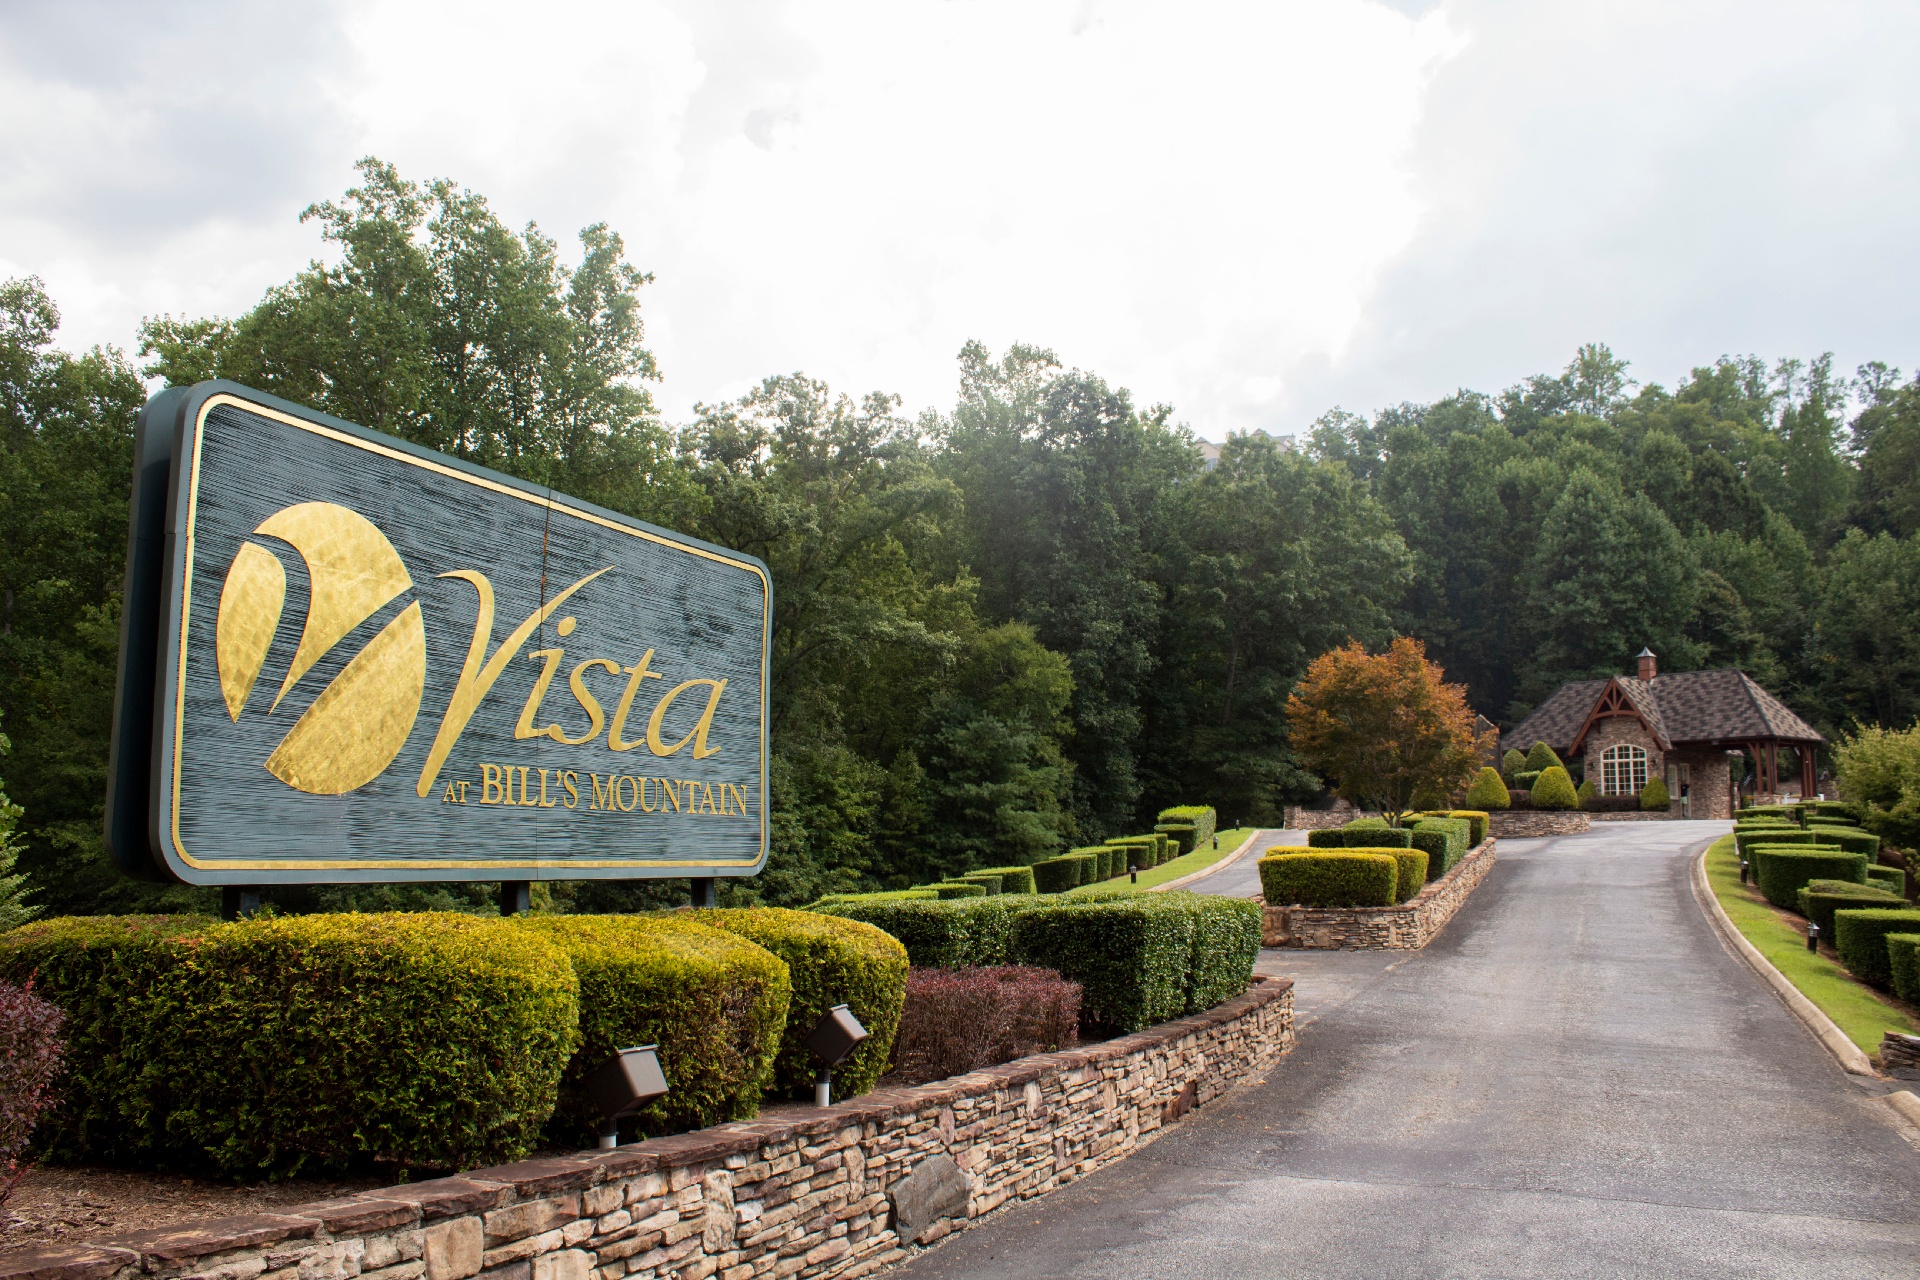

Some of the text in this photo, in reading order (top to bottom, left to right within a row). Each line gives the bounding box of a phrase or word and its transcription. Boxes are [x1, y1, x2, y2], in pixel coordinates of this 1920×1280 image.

[416, 565, 728, 797] Vista
[442, 780, 471, 803] AT
[589, 772, 748, 816] MOUNTAIN
